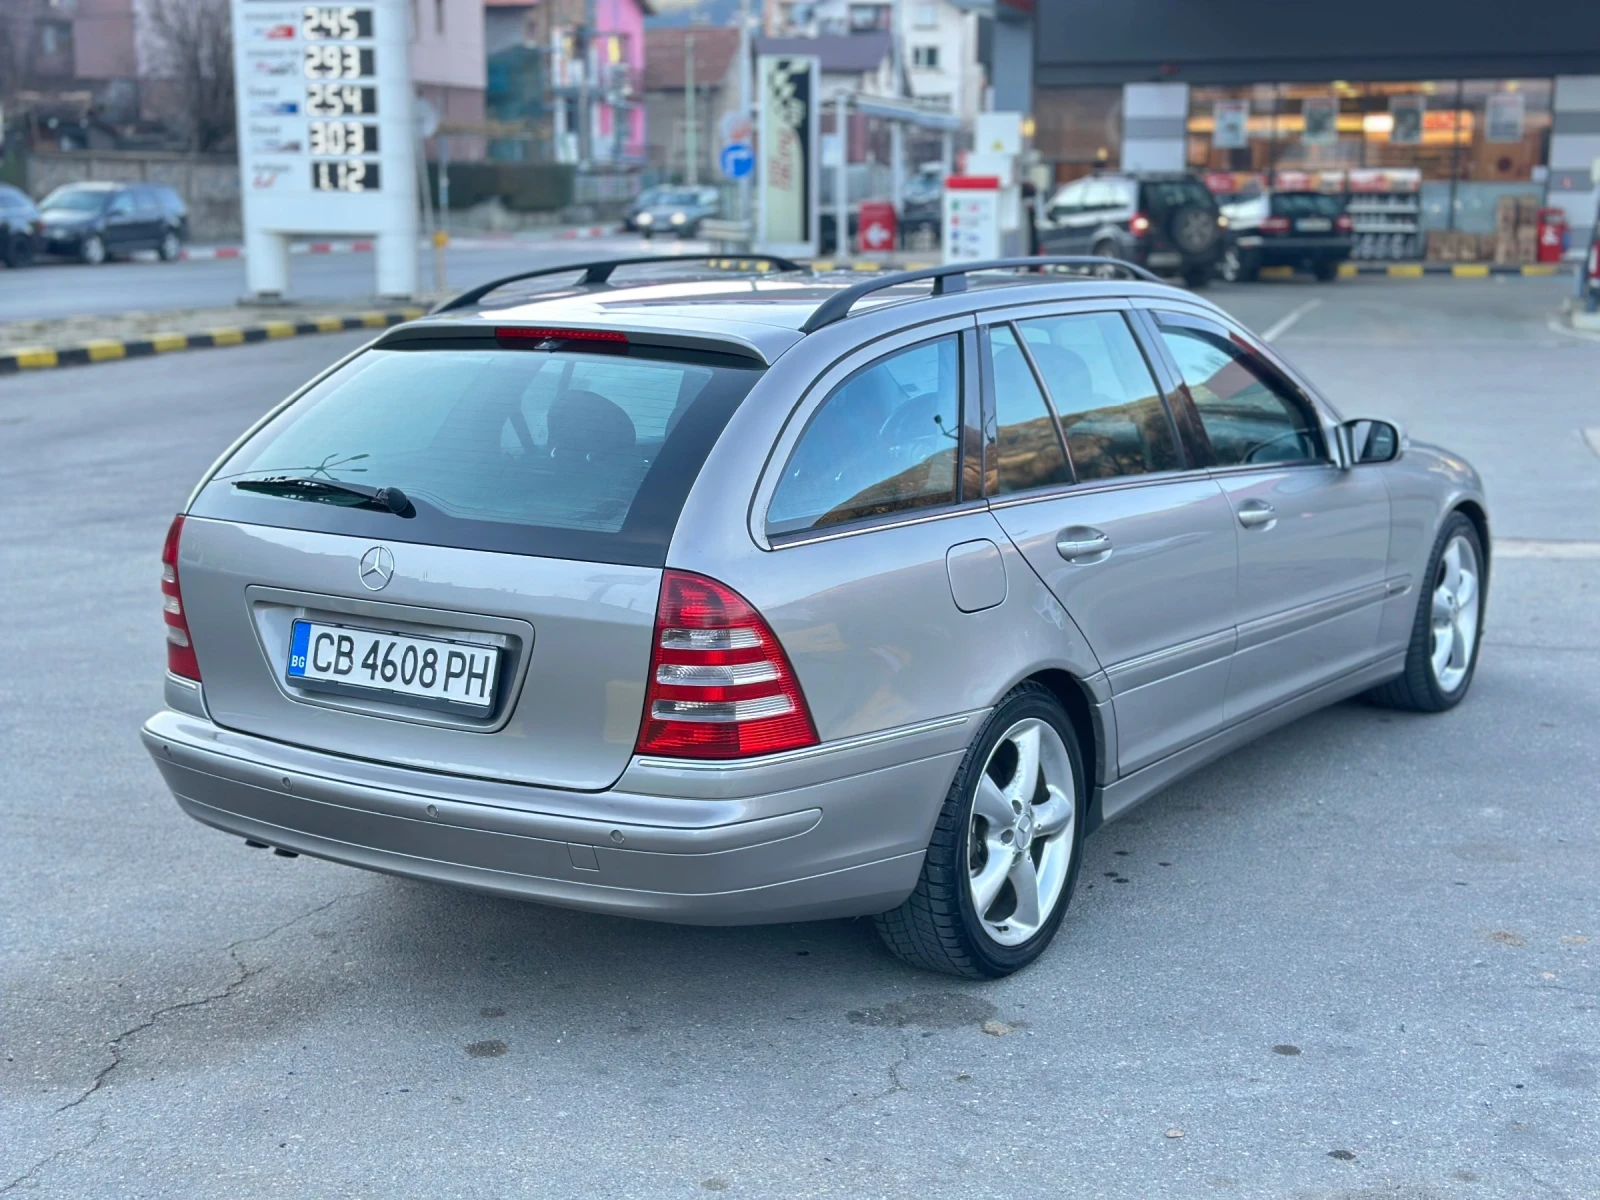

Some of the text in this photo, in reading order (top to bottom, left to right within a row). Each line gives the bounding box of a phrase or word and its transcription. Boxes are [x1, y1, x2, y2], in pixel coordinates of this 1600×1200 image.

[291, 655, 306, 669] BG
[312, 632, 491, 698] CB 4608 PH
